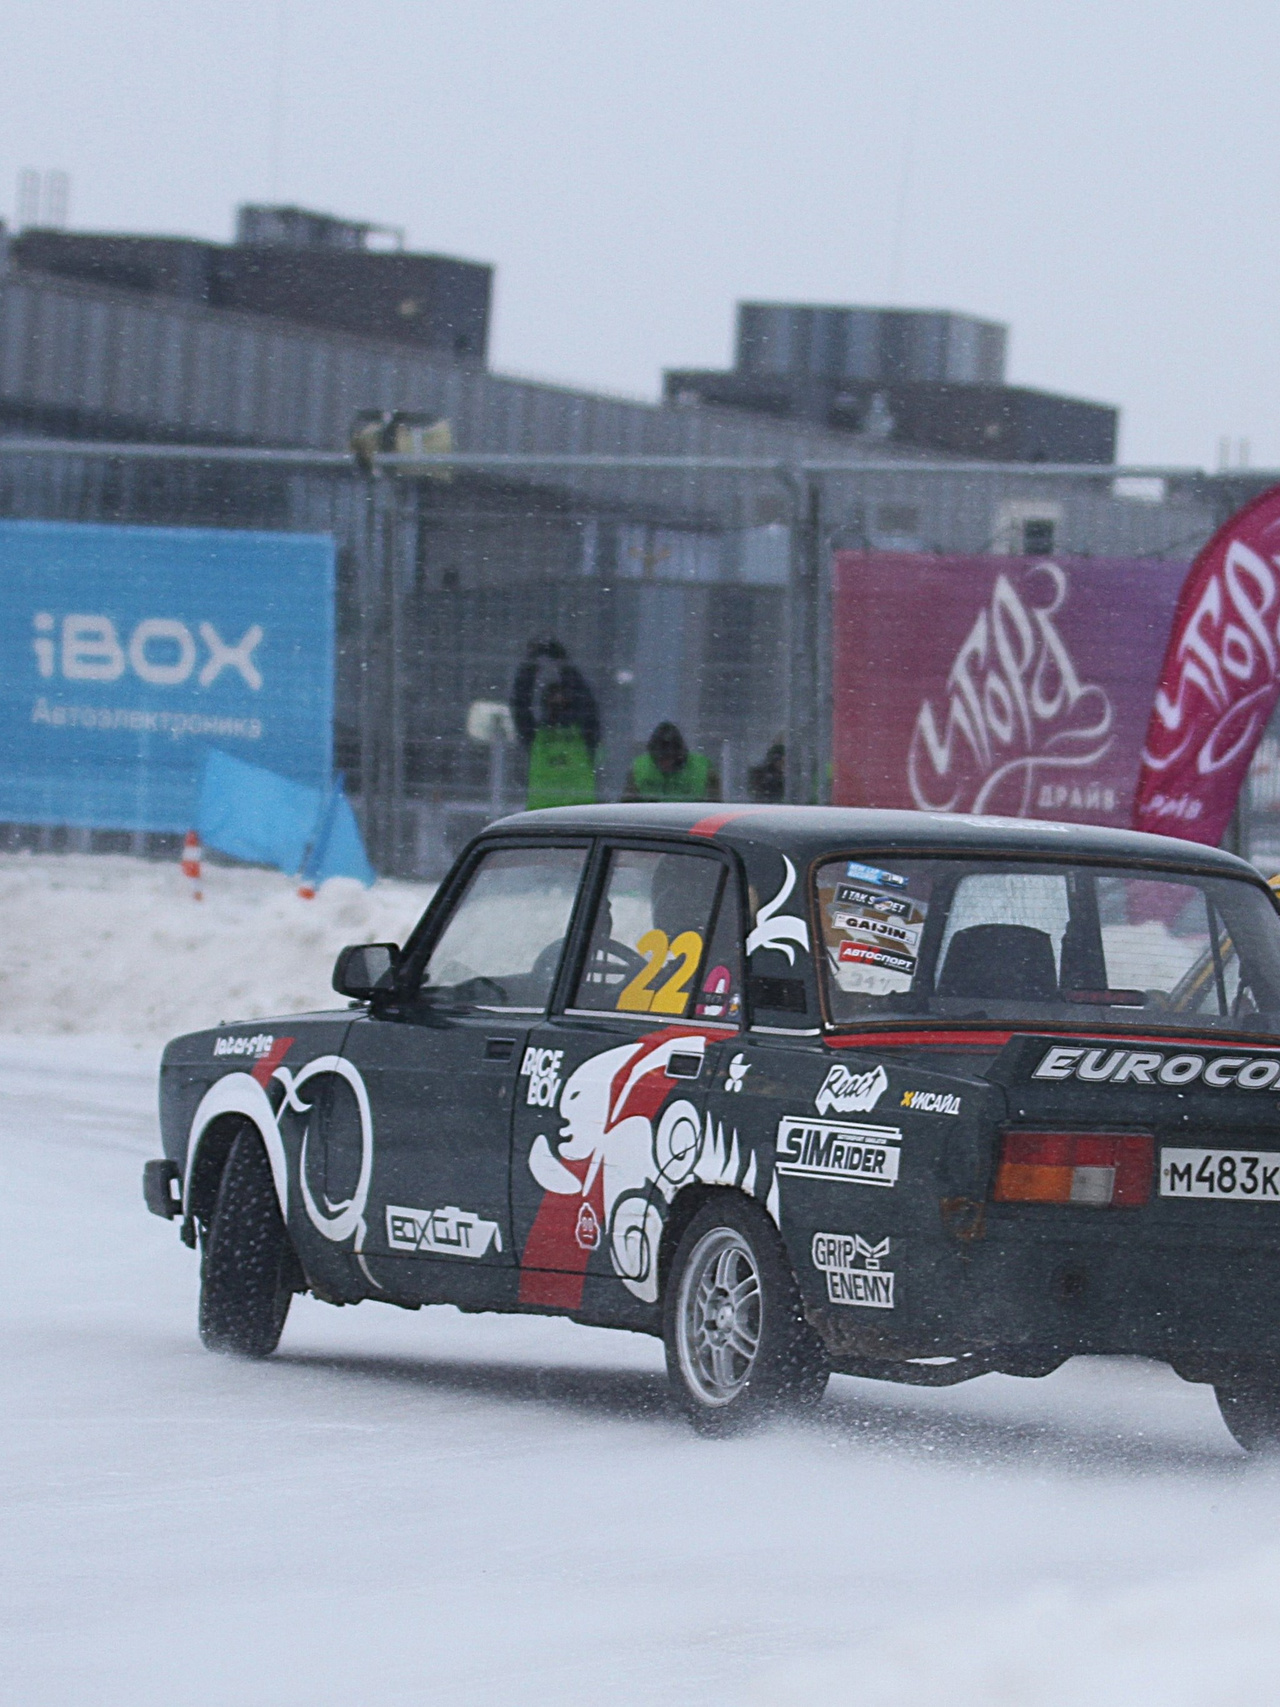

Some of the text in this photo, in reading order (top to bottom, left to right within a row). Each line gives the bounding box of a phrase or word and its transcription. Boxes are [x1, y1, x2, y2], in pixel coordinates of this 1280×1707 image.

[33, 612, 265, 691] iBOX
[846, 917, 907, 940] GAIJIN
[615, 929, 703, 1014] 22
[842, 947, 913, 969] АВТОСПОРТ
[520, 1046, 564, 1080] RACE
[526, 1074, 562, 1108] BOY
[813, 1235, 856, 1270] GRIP
[828, 1271, 894, 1305] ENEMY
